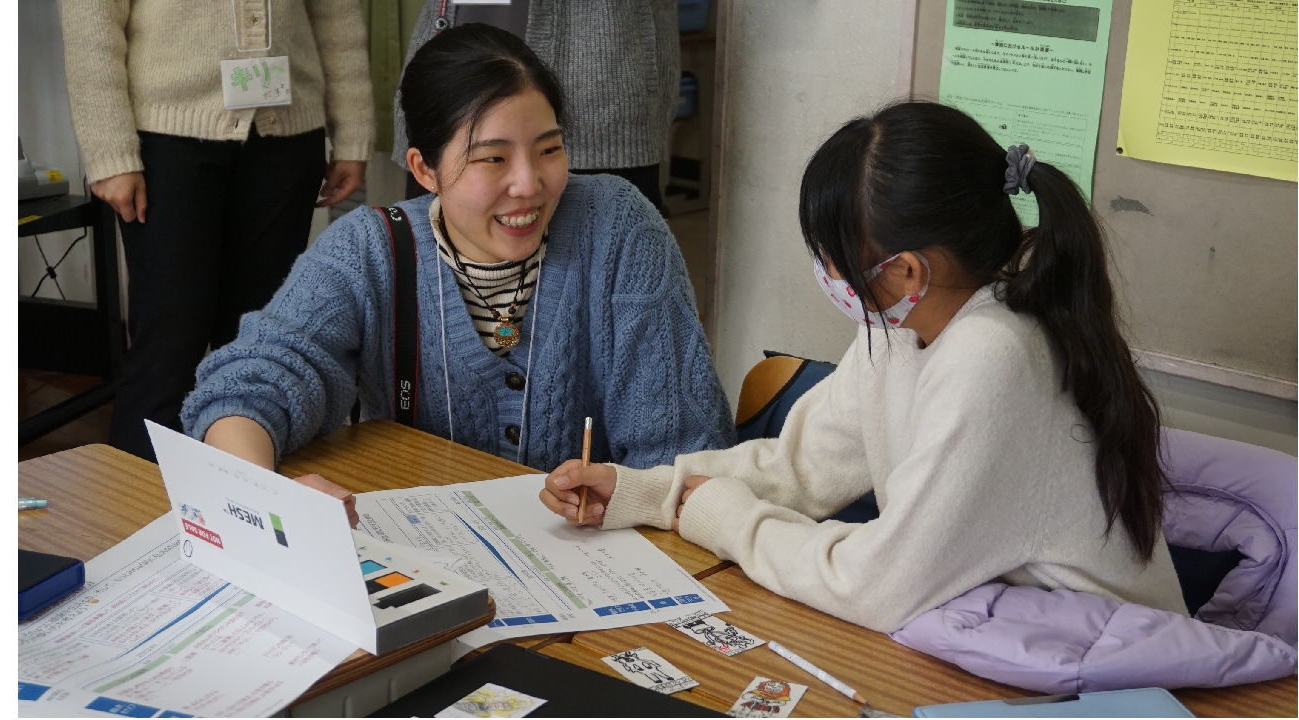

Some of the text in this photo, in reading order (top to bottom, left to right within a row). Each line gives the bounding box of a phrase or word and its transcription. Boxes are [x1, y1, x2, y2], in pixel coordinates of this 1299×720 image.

[400, 380, 411, 410] EOS
[185, 523, 198, 534] SALE
[199, 529, 210, 539] FOR
